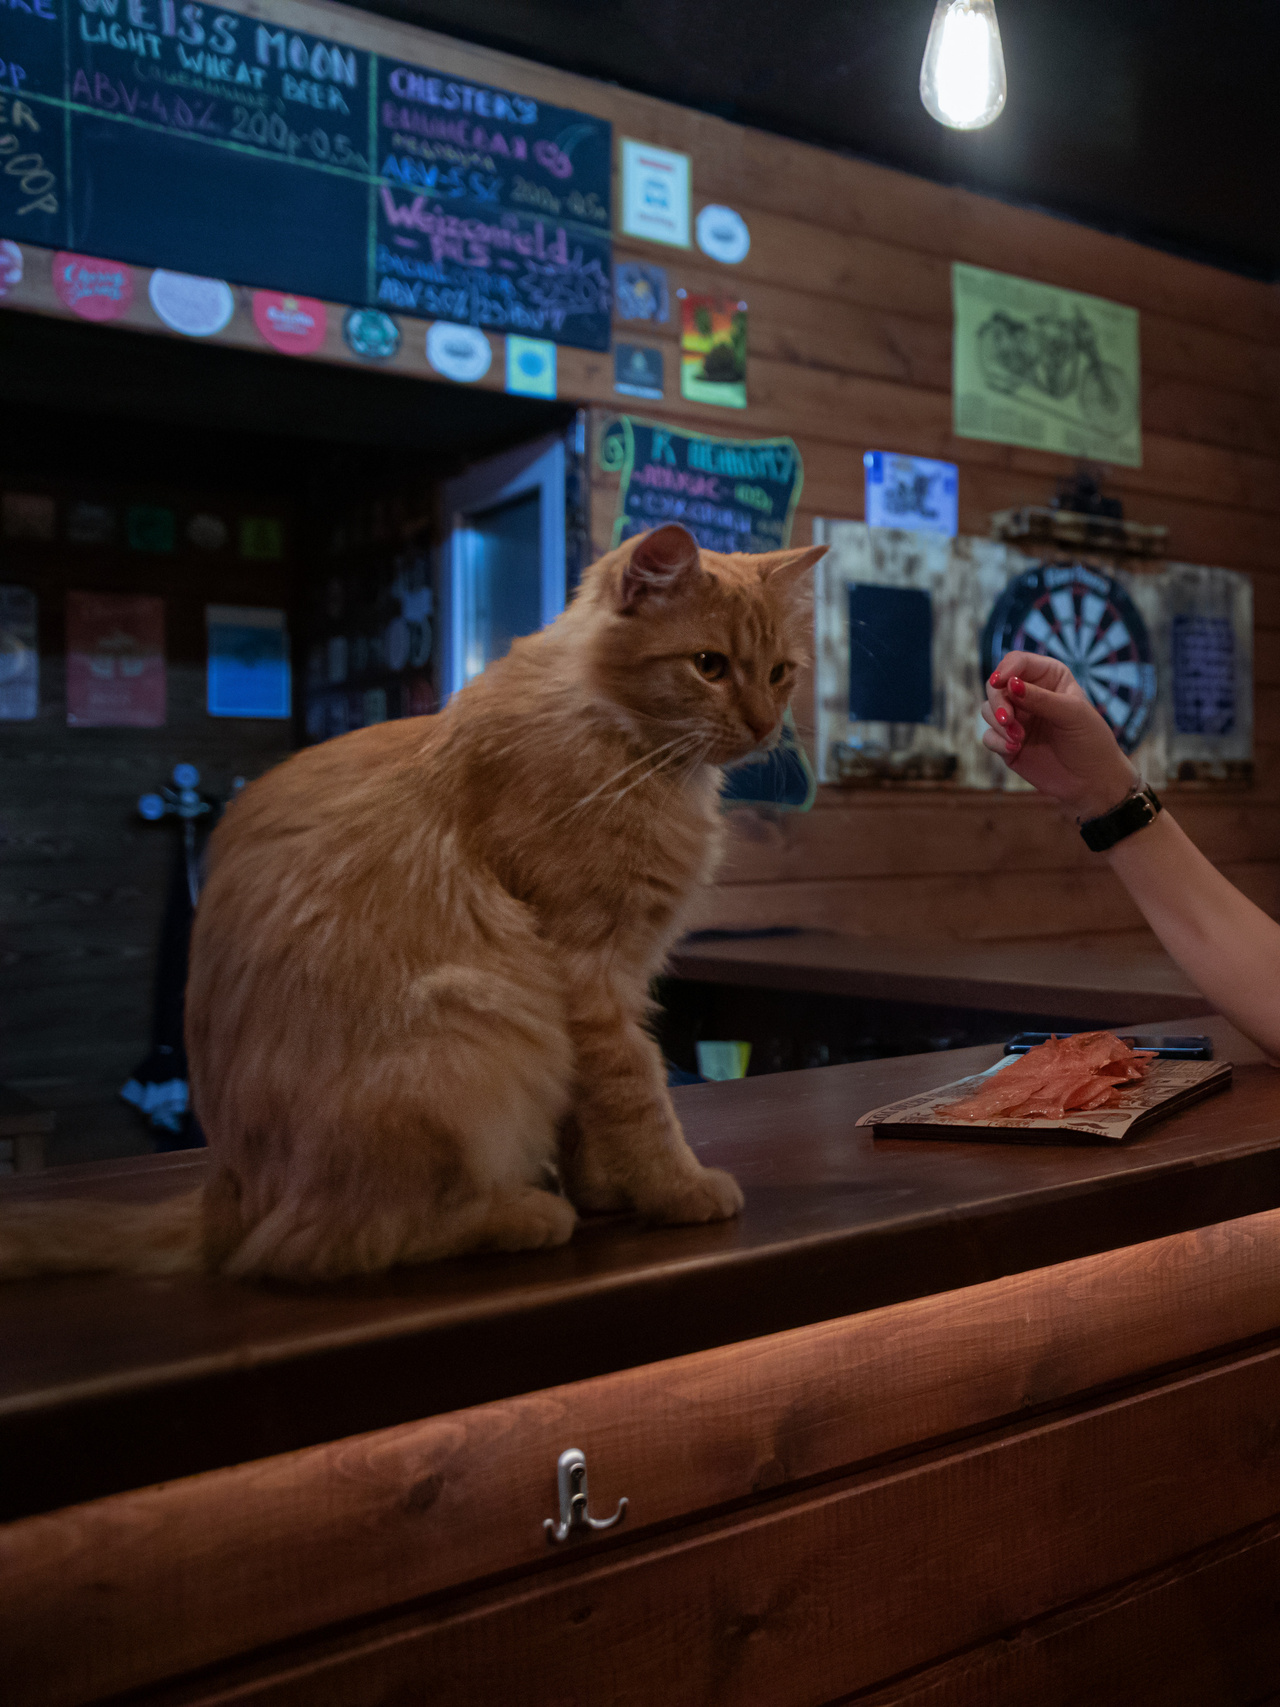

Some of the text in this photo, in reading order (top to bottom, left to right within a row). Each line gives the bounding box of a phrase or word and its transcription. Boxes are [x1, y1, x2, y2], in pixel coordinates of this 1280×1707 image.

[80, 14, 161, 59] LIGHT
[177, 44, 265, 89] WHEAT
[282, 74, 350, 115] BEER
[256, 25, 356, 88] MOON
